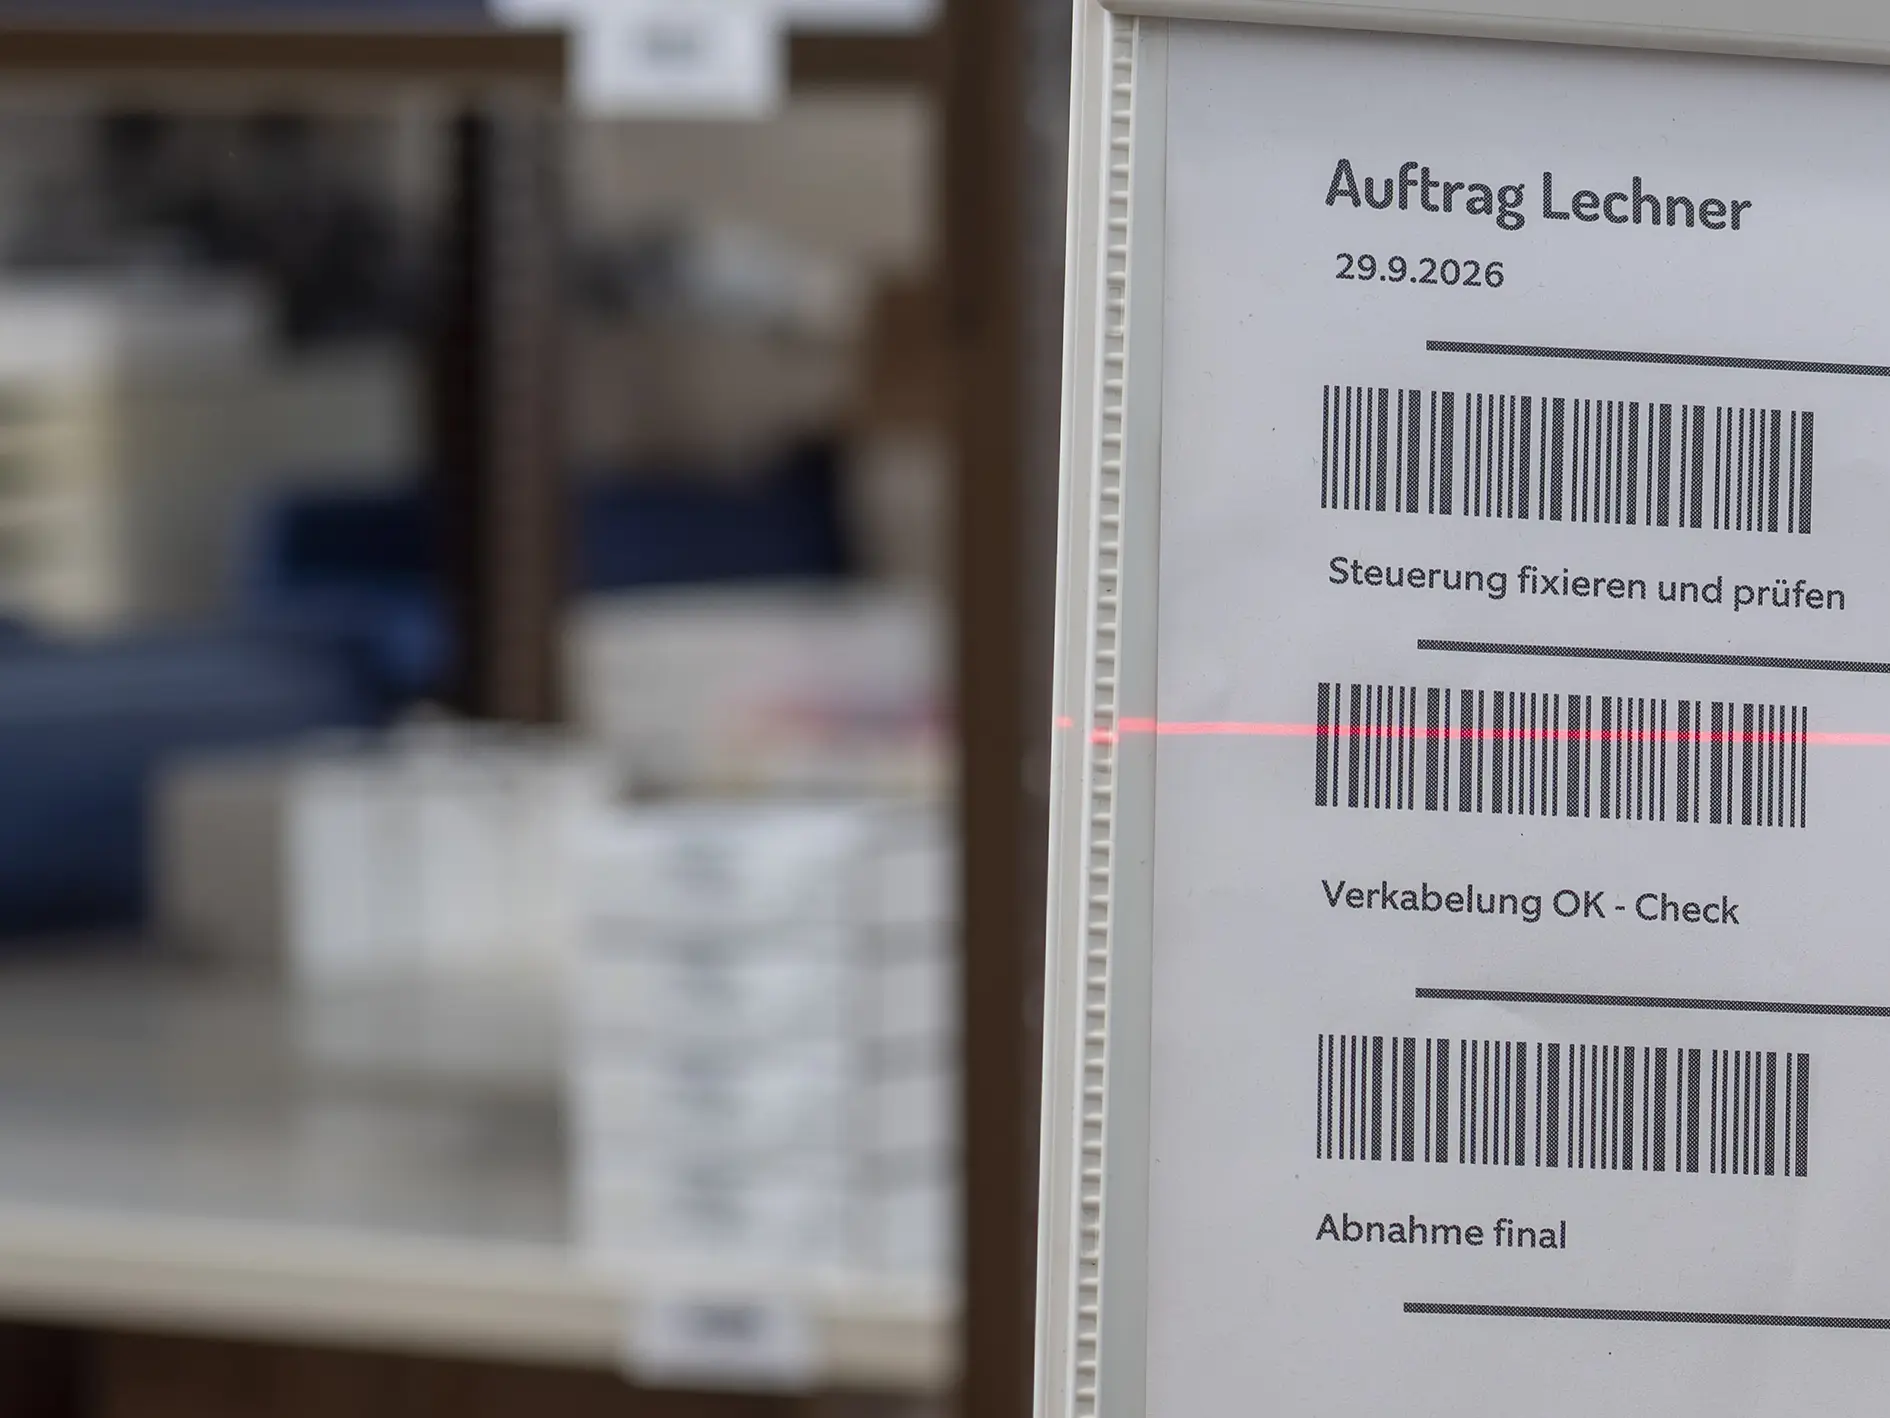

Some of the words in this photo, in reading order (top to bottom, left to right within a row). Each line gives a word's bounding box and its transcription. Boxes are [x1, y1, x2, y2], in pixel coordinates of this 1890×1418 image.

[1324, 158, 1526, 232] Auftrag
[1542, 171, 1753, 231] Lechner
[1335, 252, 1505, 289] 29.9.2026
[1328, 556, 1508, 600] Steuerung
[1517, 564, 1647, 600] fixieren
[1658, 575, 1723, 604] und
[1733, 578, 1845, 613] prüfen
[1321, 879, 1542, 924] Verkabelung
[1552, 889, 1606, 919] OK
[1635, 892, 1740, 925] Check
[1315, 1212, 1484, 1247] Abnahme
[1492, 1217, 1567, 1250] final
